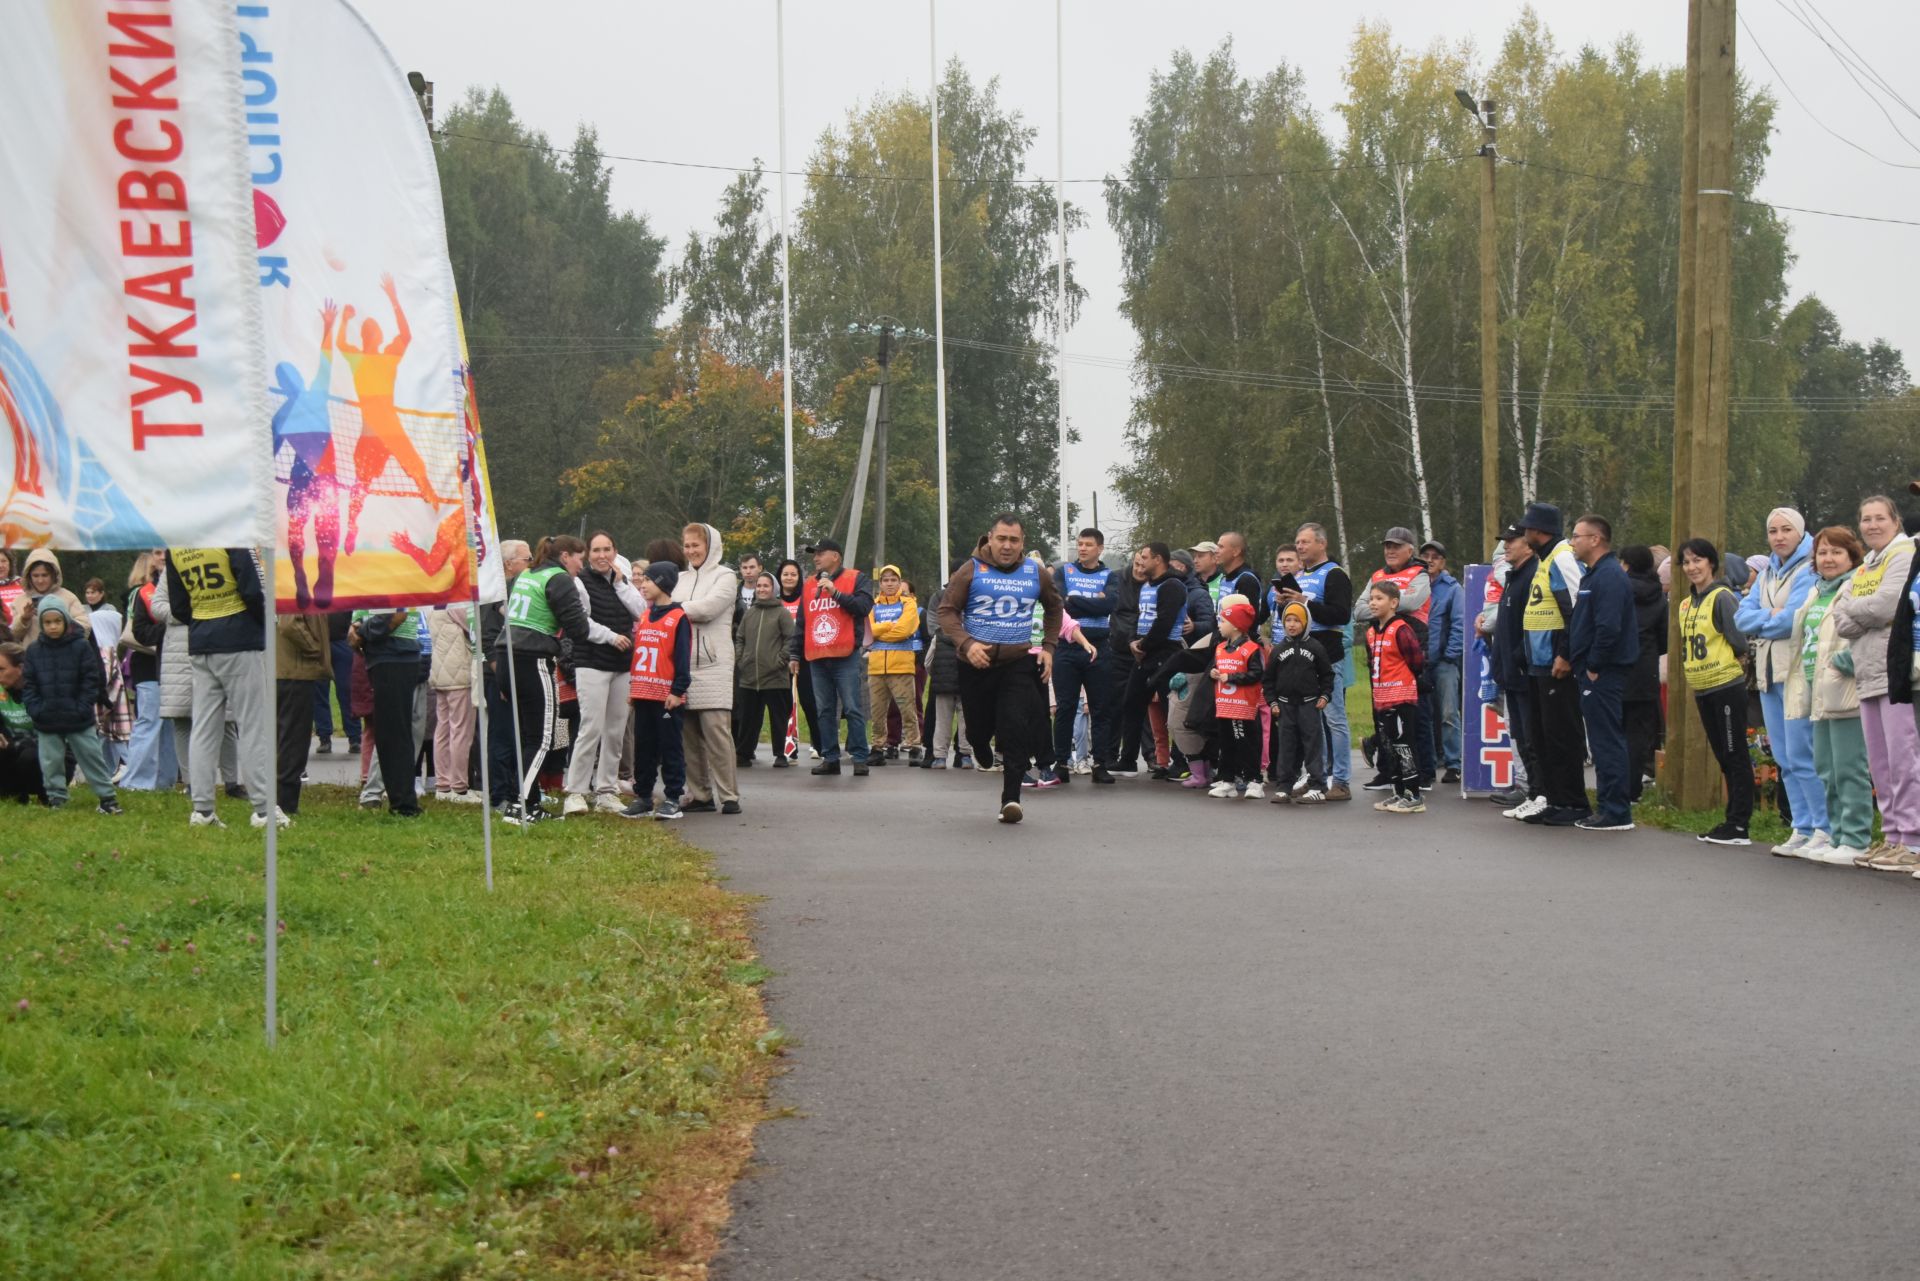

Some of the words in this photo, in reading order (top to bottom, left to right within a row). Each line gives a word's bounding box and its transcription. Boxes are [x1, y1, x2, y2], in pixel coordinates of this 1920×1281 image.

[107, 0, 204, 451] ТУКАЕВСКИ
[257, 255, 290, 289] Я
[982, 577, 1033, 588] ТУКАЕВСКИЙ
[993, 584, 1024, 593] РАЙОН
[508, 592, 532, 620] 21
[809, 597, 841, 612] СУДЬ
[972, 594, 1036, 618] 203
[634, 645, 659, 673] 21
